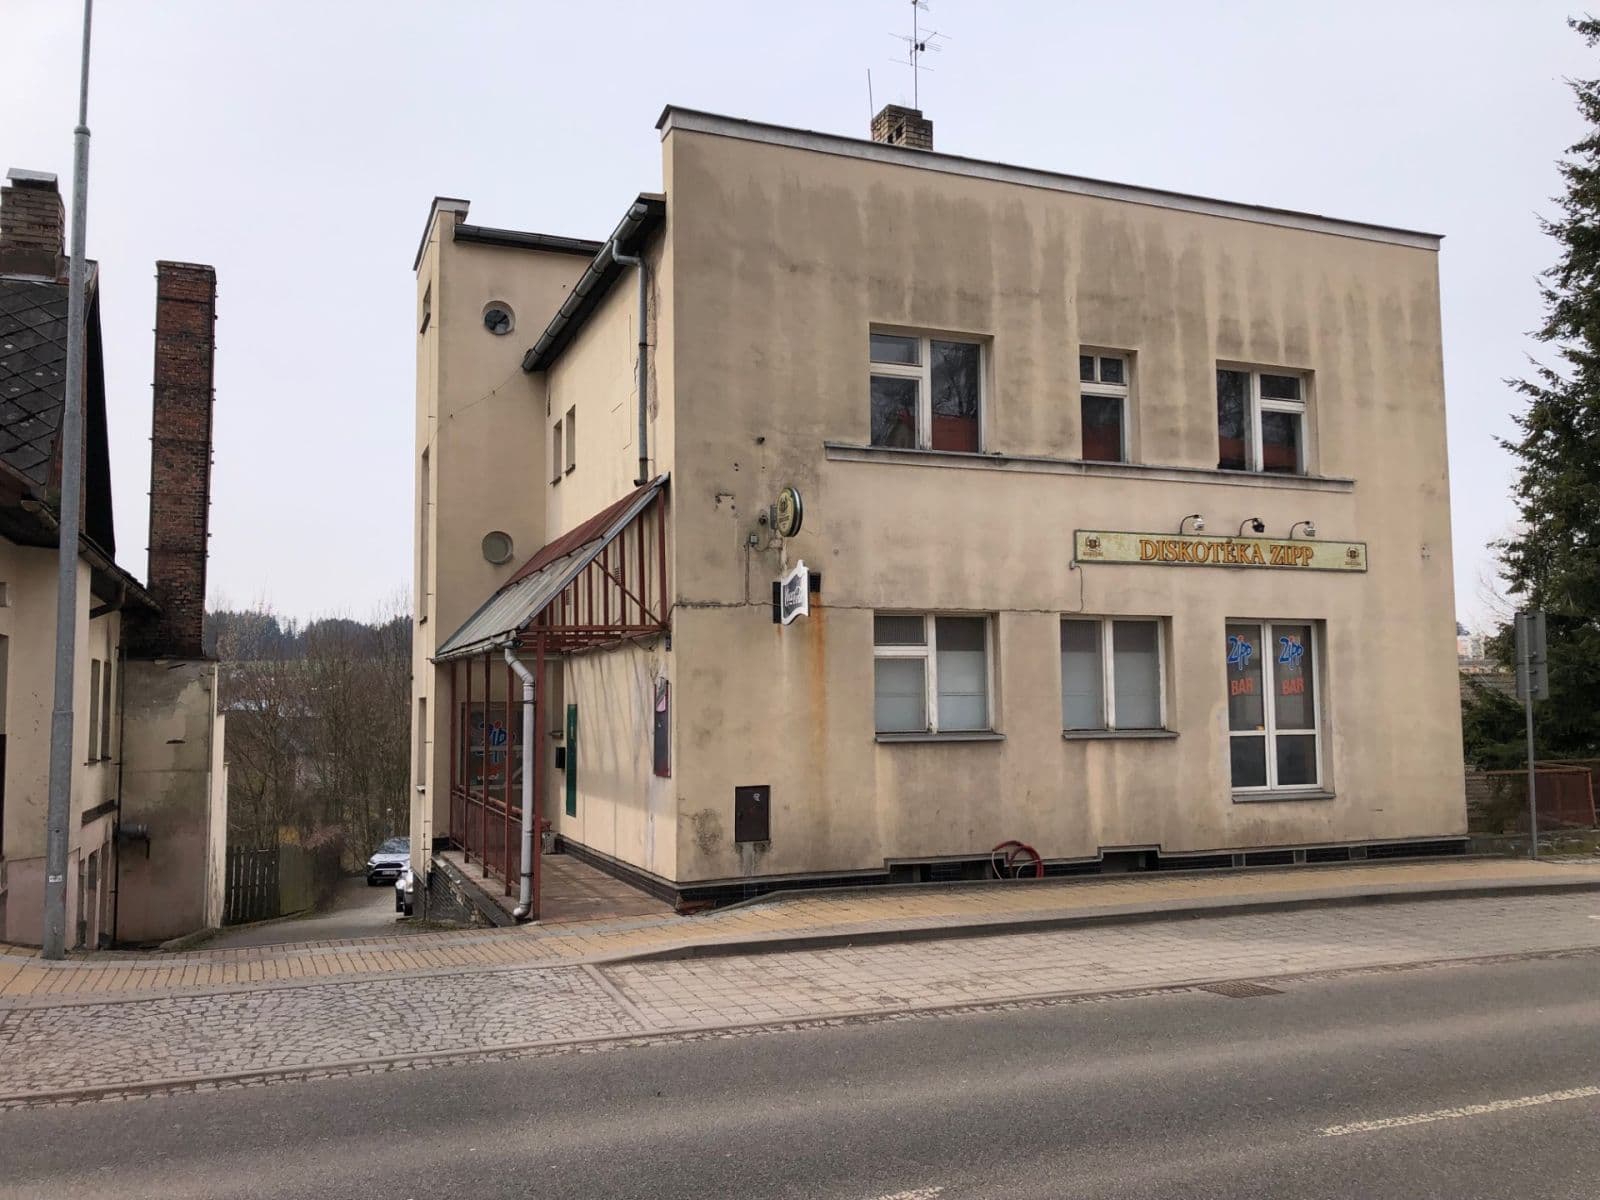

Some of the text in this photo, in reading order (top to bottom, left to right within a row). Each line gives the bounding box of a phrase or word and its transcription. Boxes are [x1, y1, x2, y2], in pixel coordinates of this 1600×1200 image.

[1269, 544, 1314, 566] ZIPP
[1231, 677, 1254, 696] BAR
[1282, 676, 1305, 696] BAR
